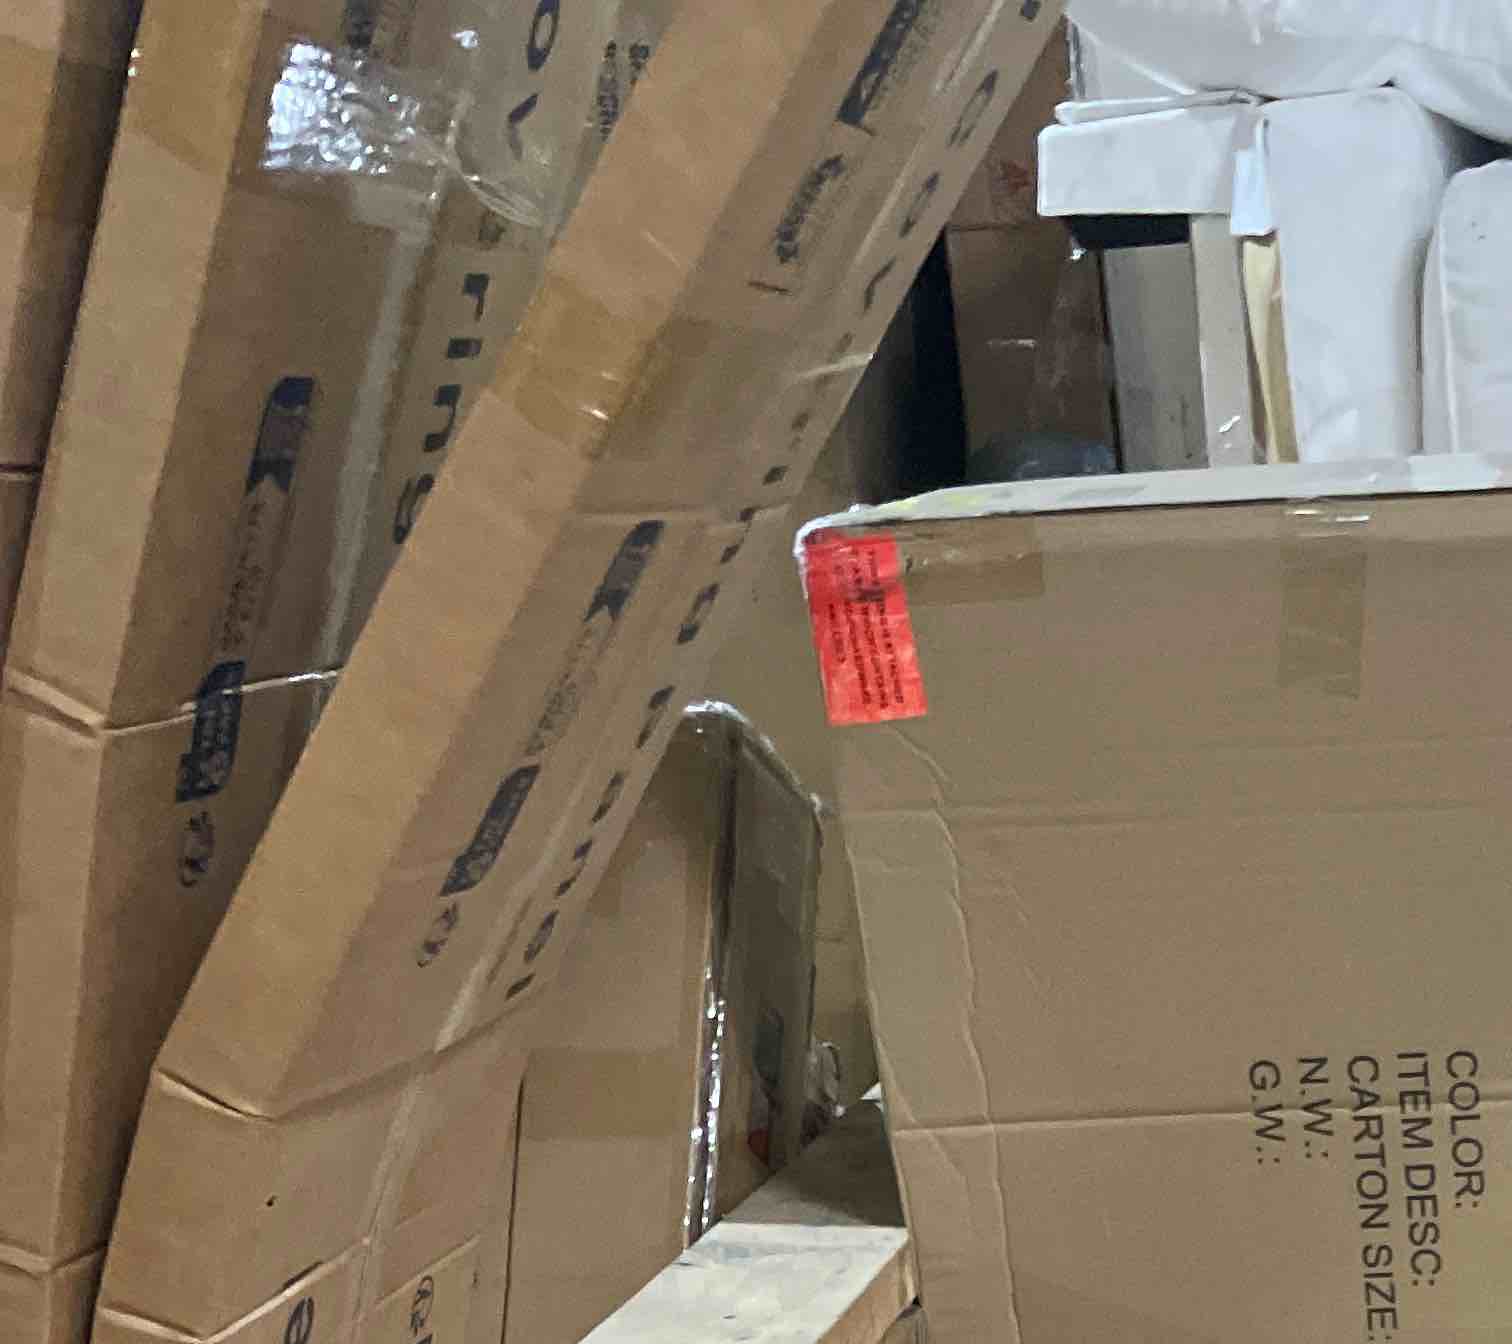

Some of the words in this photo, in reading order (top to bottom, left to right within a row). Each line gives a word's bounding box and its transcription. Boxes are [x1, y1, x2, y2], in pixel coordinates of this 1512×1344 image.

[1248, 1060, 1288, 1165] G.W.:
[1298, 1055, 1330, 1160] N.W.:
[1346, 1054, 1390, 1230] CARTON
[1396, 1051, 1433, 1150] ITEM
[1446, 1050, 1486, 1209] COLOR:
[1403, 1164, 1443, 1287] DESC:
[1361, 1243, 1400, 1341] SIZE:
